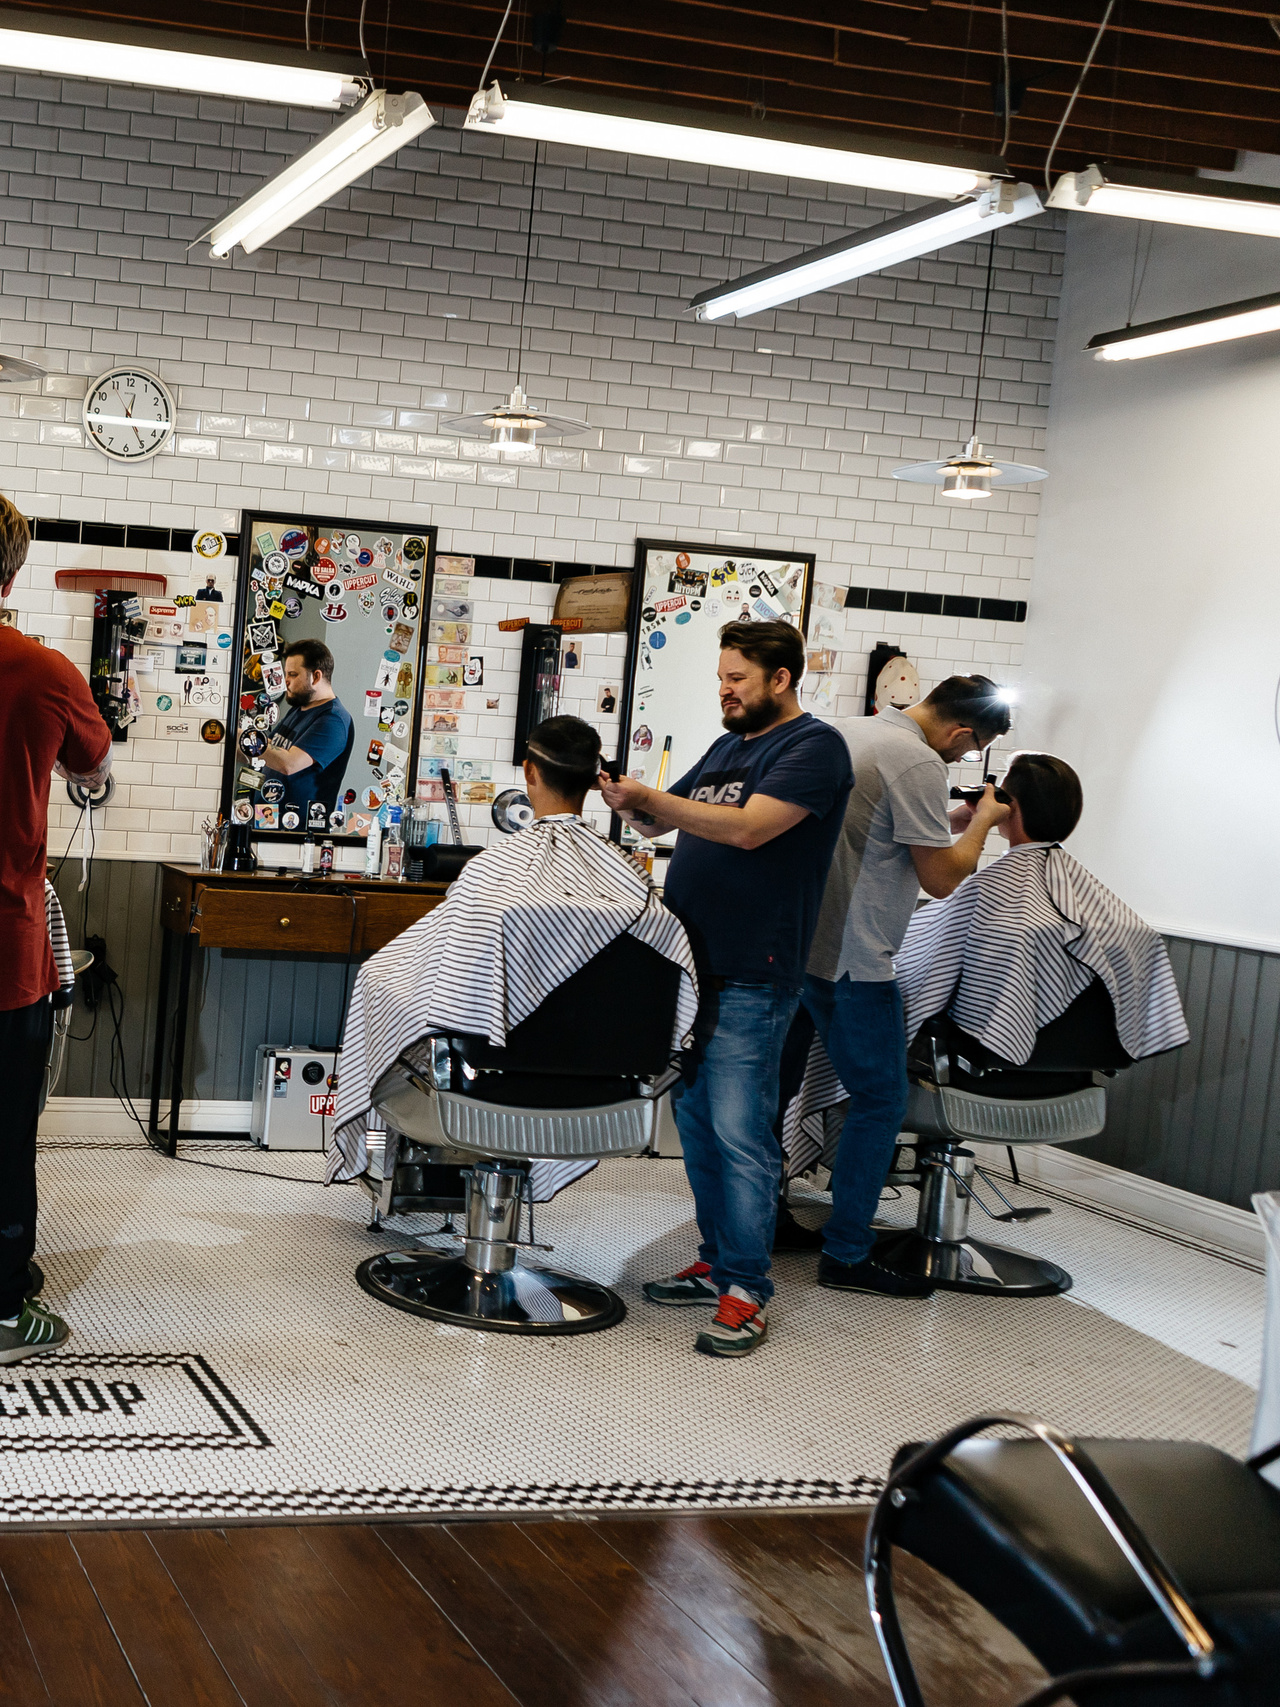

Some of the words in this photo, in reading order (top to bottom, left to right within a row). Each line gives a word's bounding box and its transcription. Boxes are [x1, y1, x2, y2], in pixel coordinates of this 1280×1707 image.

[112, 381, 119, 390] 11
[126, 378, 135, 387] 12
[144, 384, 148, 393] 1
[98, 392, 107, 401] 10
[153, 397, 159, 406] 2
[157, 414, 162, 422] 3
[97, 425, 103, 434] 8
[151, 429, 157, 438] 4
[108, 437, 114, 446] 7
[139, 440, 145, 449] 5
[123, 444, 129, 452] 6
[344, 575, 376, 590] UPPERCUT
[387, 570, 412, 590] WAHL
[174, 595, 195, 606] JVCR
[656, 597, 685, 612] UPPERCUT
[551, 618, 582, 628] UPPERCUT
